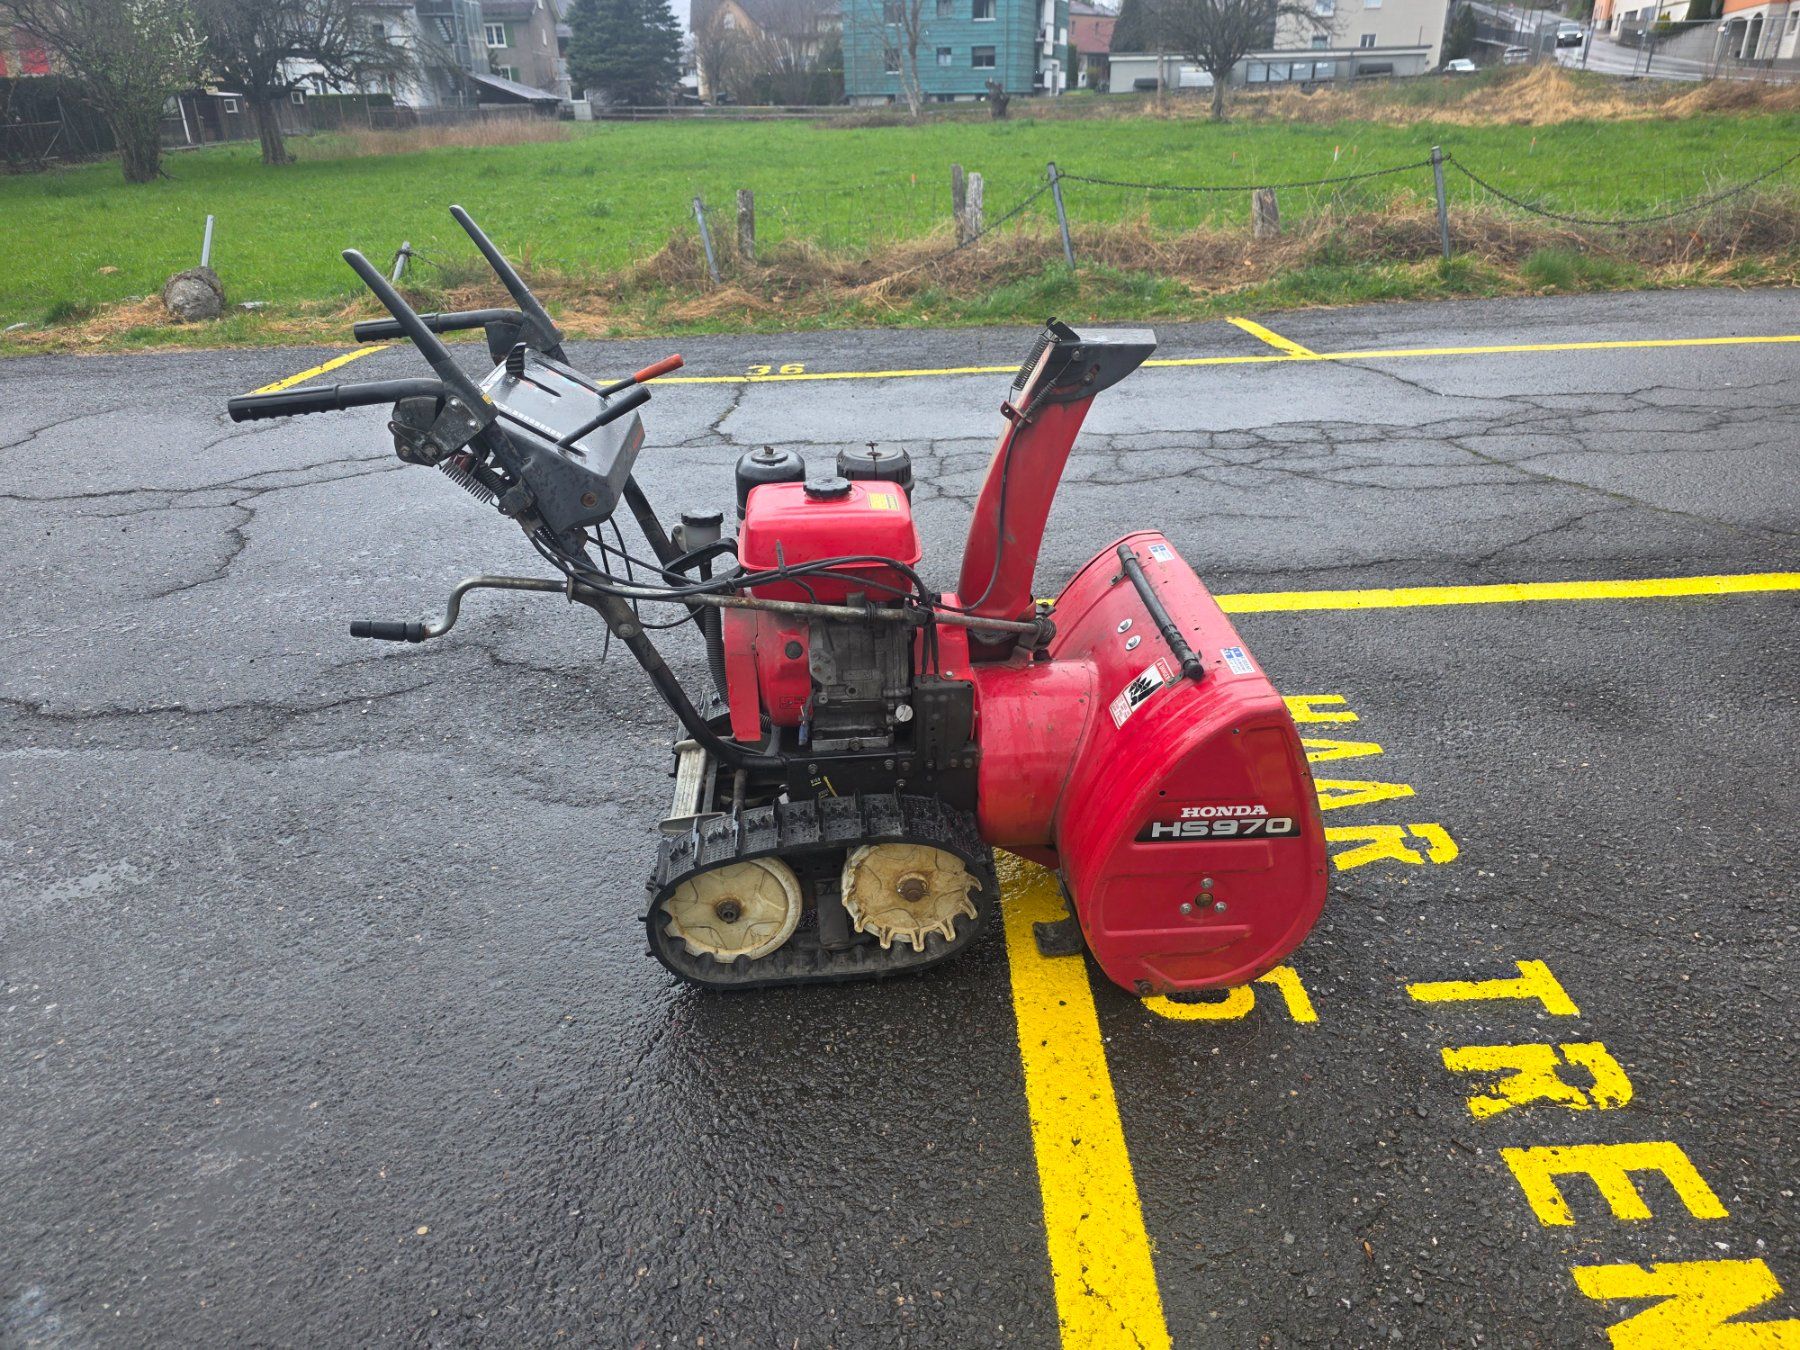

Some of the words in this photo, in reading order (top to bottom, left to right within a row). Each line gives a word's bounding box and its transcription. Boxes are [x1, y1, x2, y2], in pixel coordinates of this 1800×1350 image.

[744, 363, 805, 377] 36
[1180, 804, 1269, 818] HONDA
[1151, 817, 1293, 838] HS970
